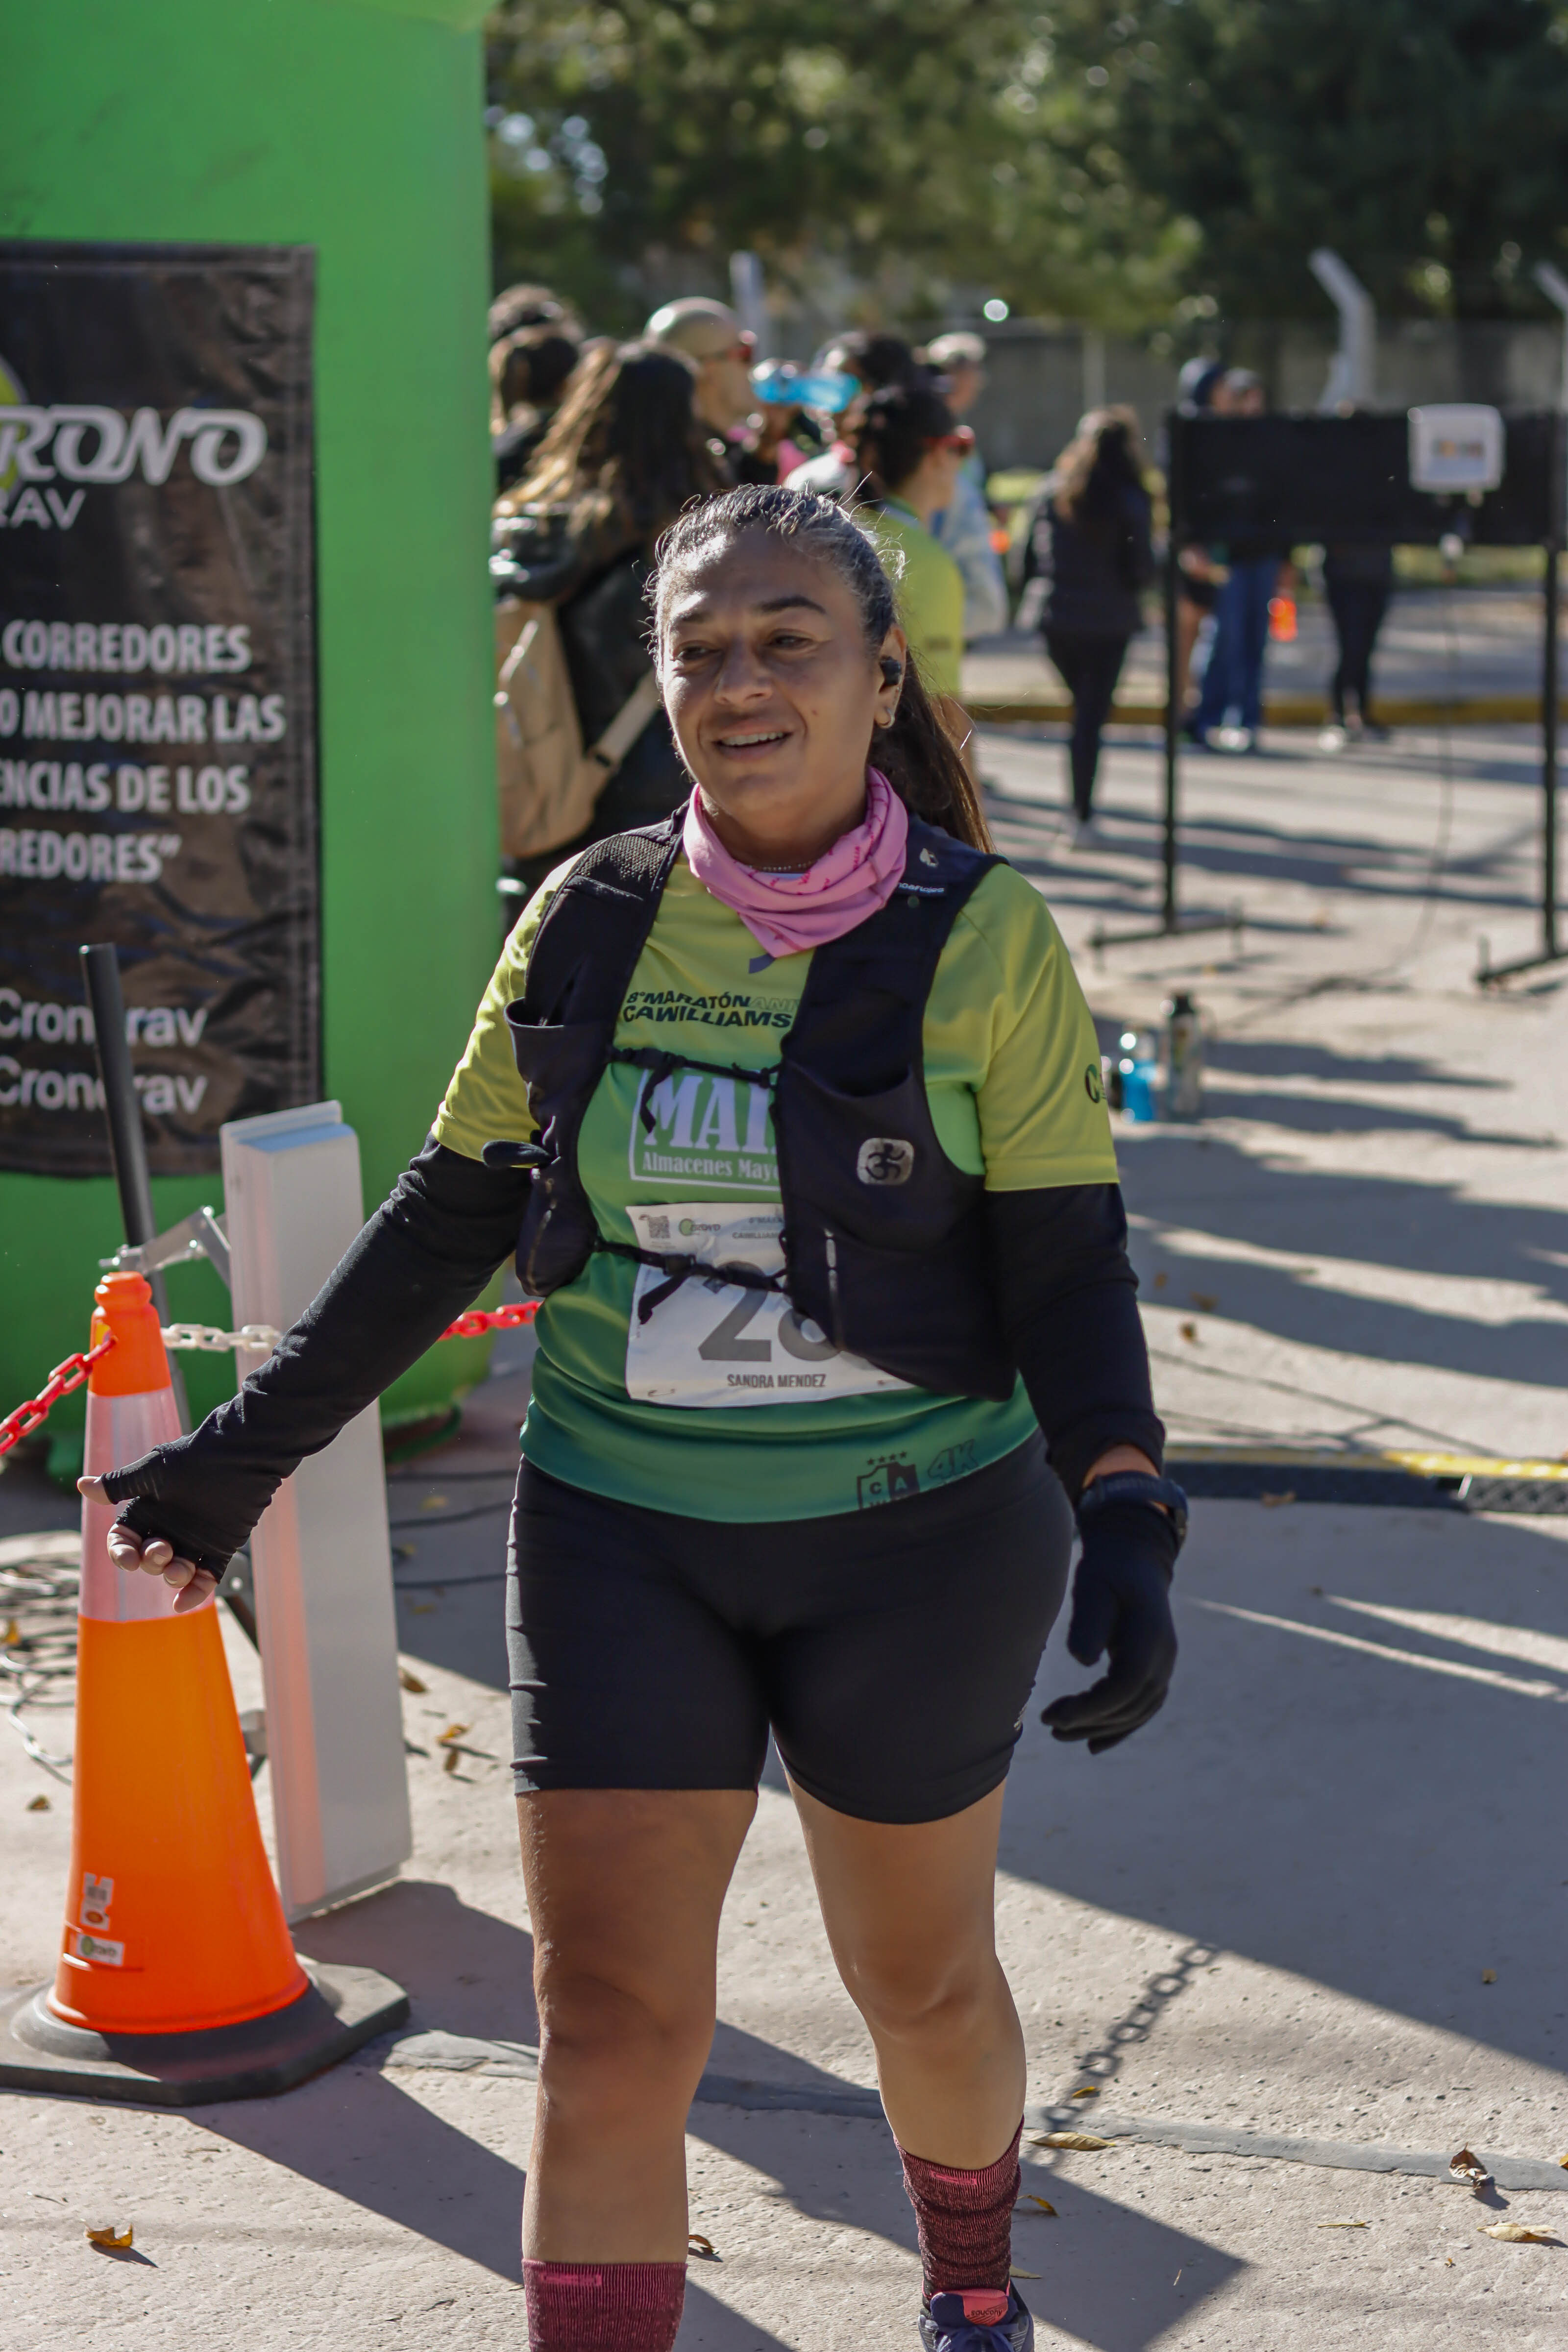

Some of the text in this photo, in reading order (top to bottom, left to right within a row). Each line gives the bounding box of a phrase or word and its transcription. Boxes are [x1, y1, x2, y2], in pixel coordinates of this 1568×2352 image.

[0, 487, 86, 530] AV
[2, 619, 253, 673] CORREDORES
[23, 690, 207, 744] MEJORAR
[212, 694, 288, 742] LAS
[0, 760, 252, 814] NCIAS DE LOS
[0, 987, 209, 1047] Cronrav
[623, 1005, 792, 1028] CAWILLIAMS
[644, 1074, 777, 1155] MAI
[643, 1151, 733, 1176] Almacenes
[727, 1373, 827, 1389] SANDRA MENDEZ
[971, 2308, 1003, 2317] saucony
